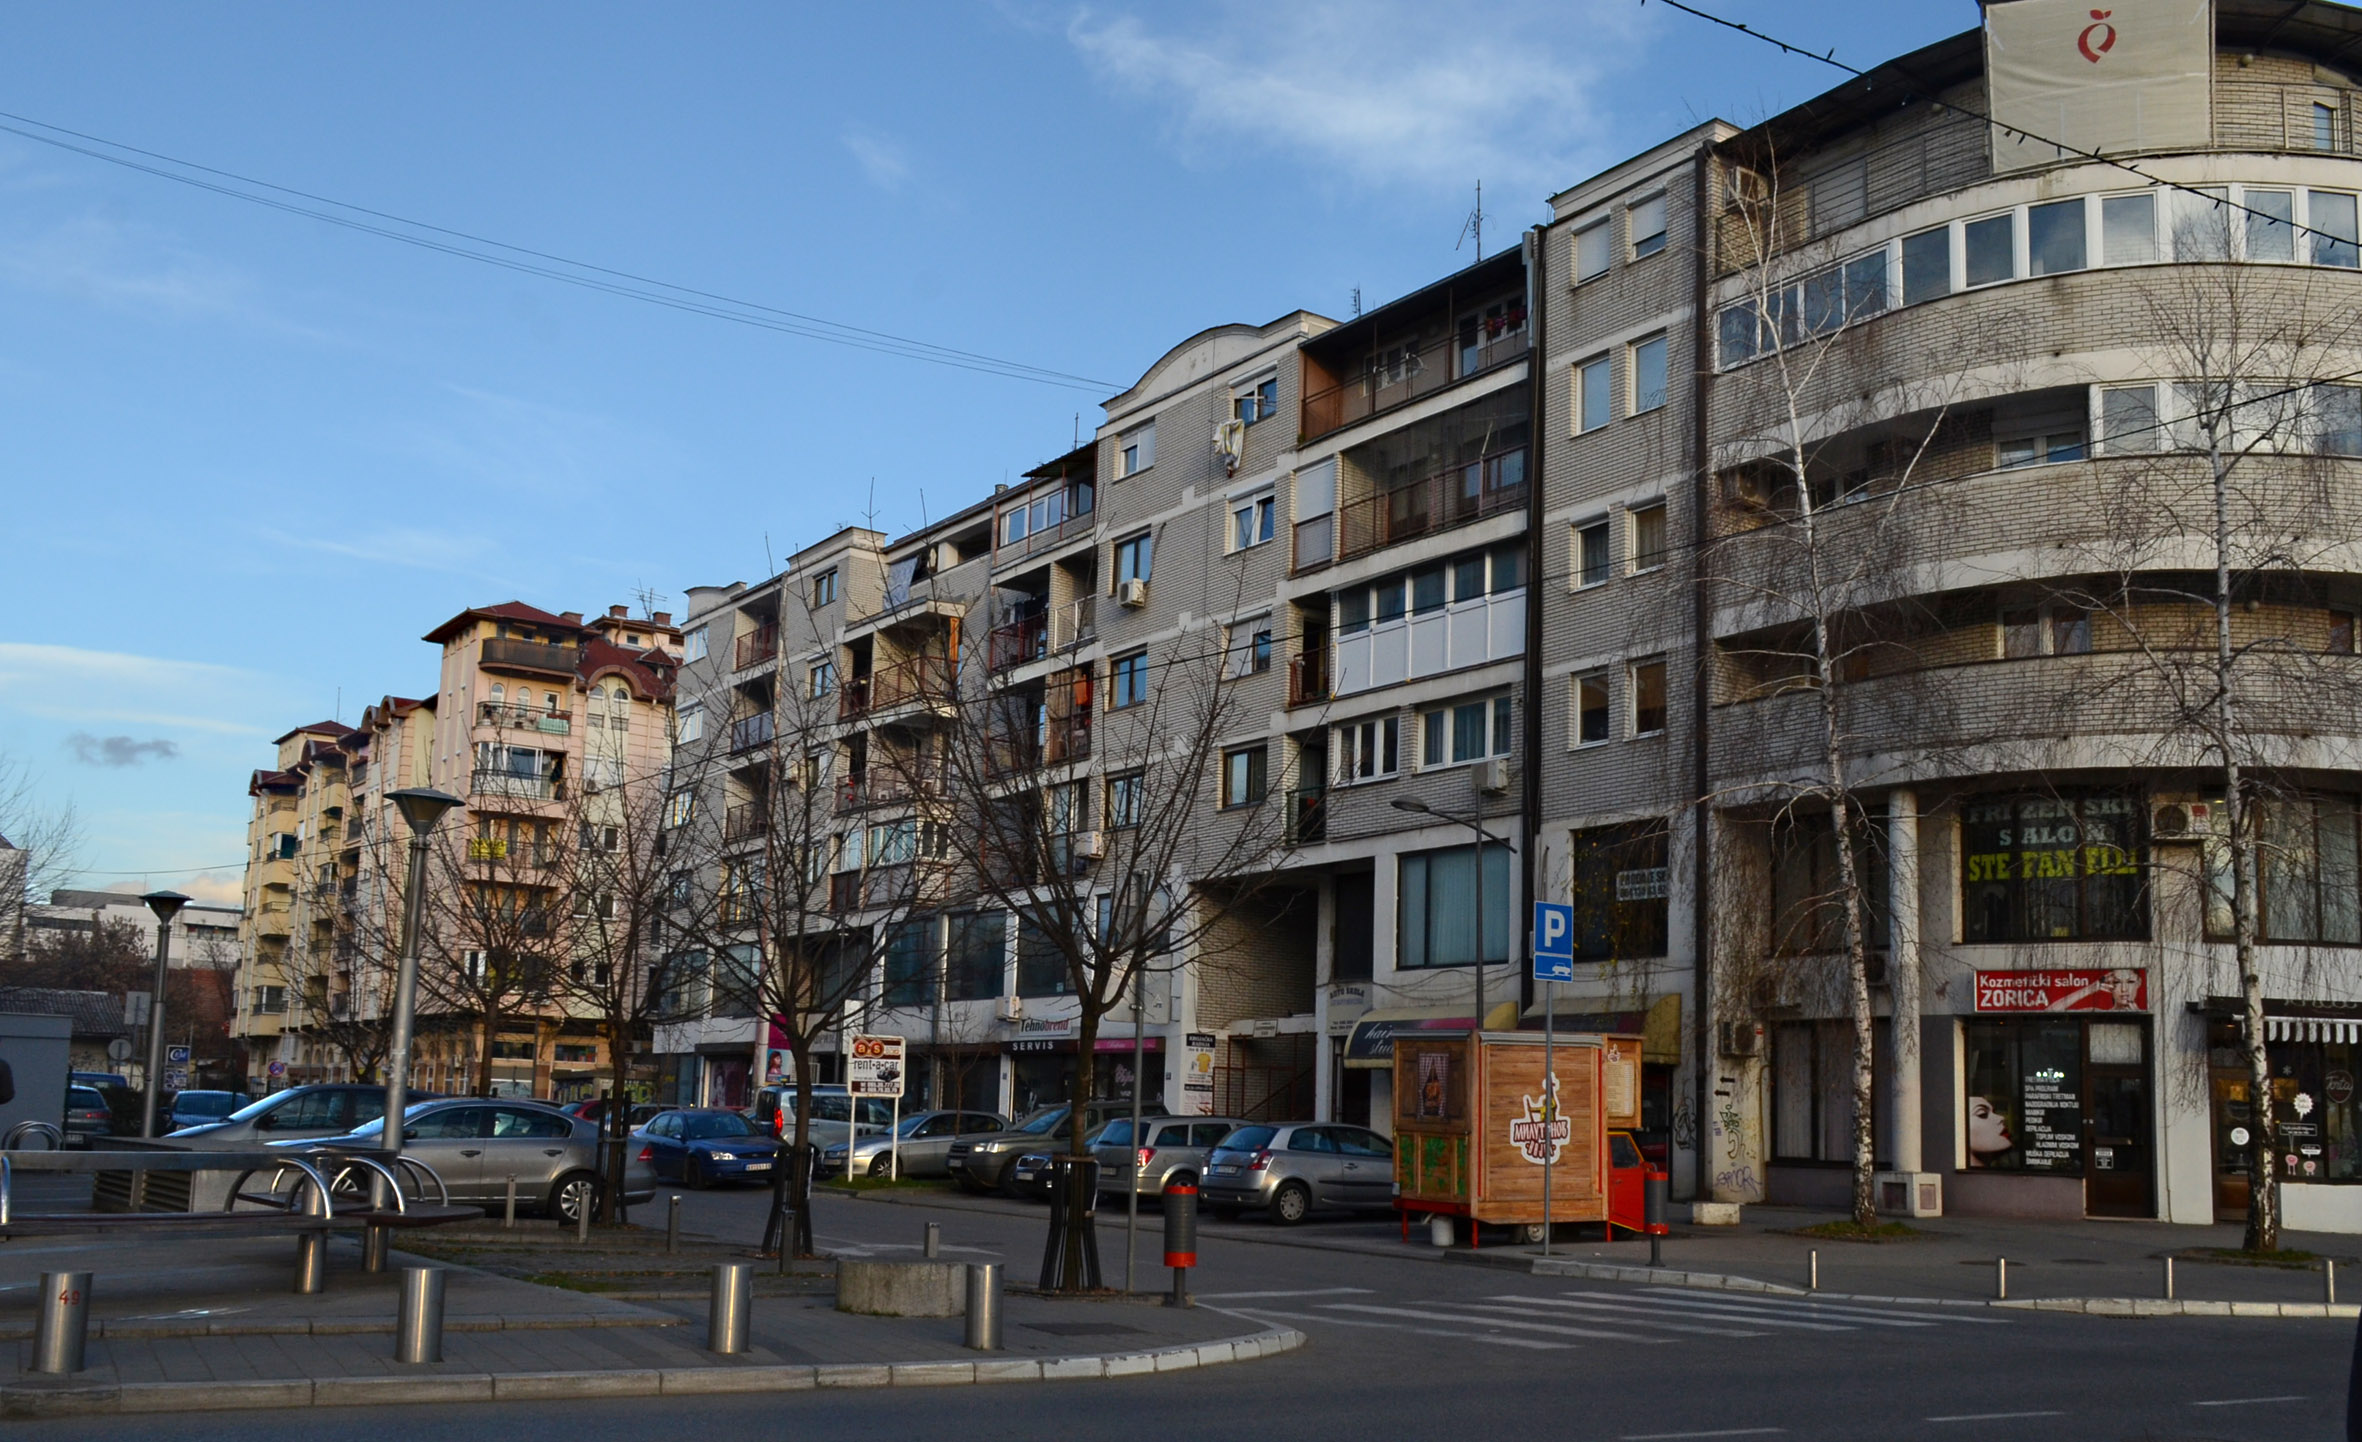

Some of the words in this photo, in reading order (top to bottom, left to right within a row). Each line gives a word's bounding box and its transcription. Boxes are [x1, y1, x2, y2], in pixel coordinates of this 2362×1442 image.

[1544, 909, 1566, 948] P
[1980, 974, 2050, 988] Kozmetički
[2054, 973, 2089, 987] salon
[1980, 989, 2049, 1007] ZORICA
[1012, 1040, 1054, 1051] SERVIS
